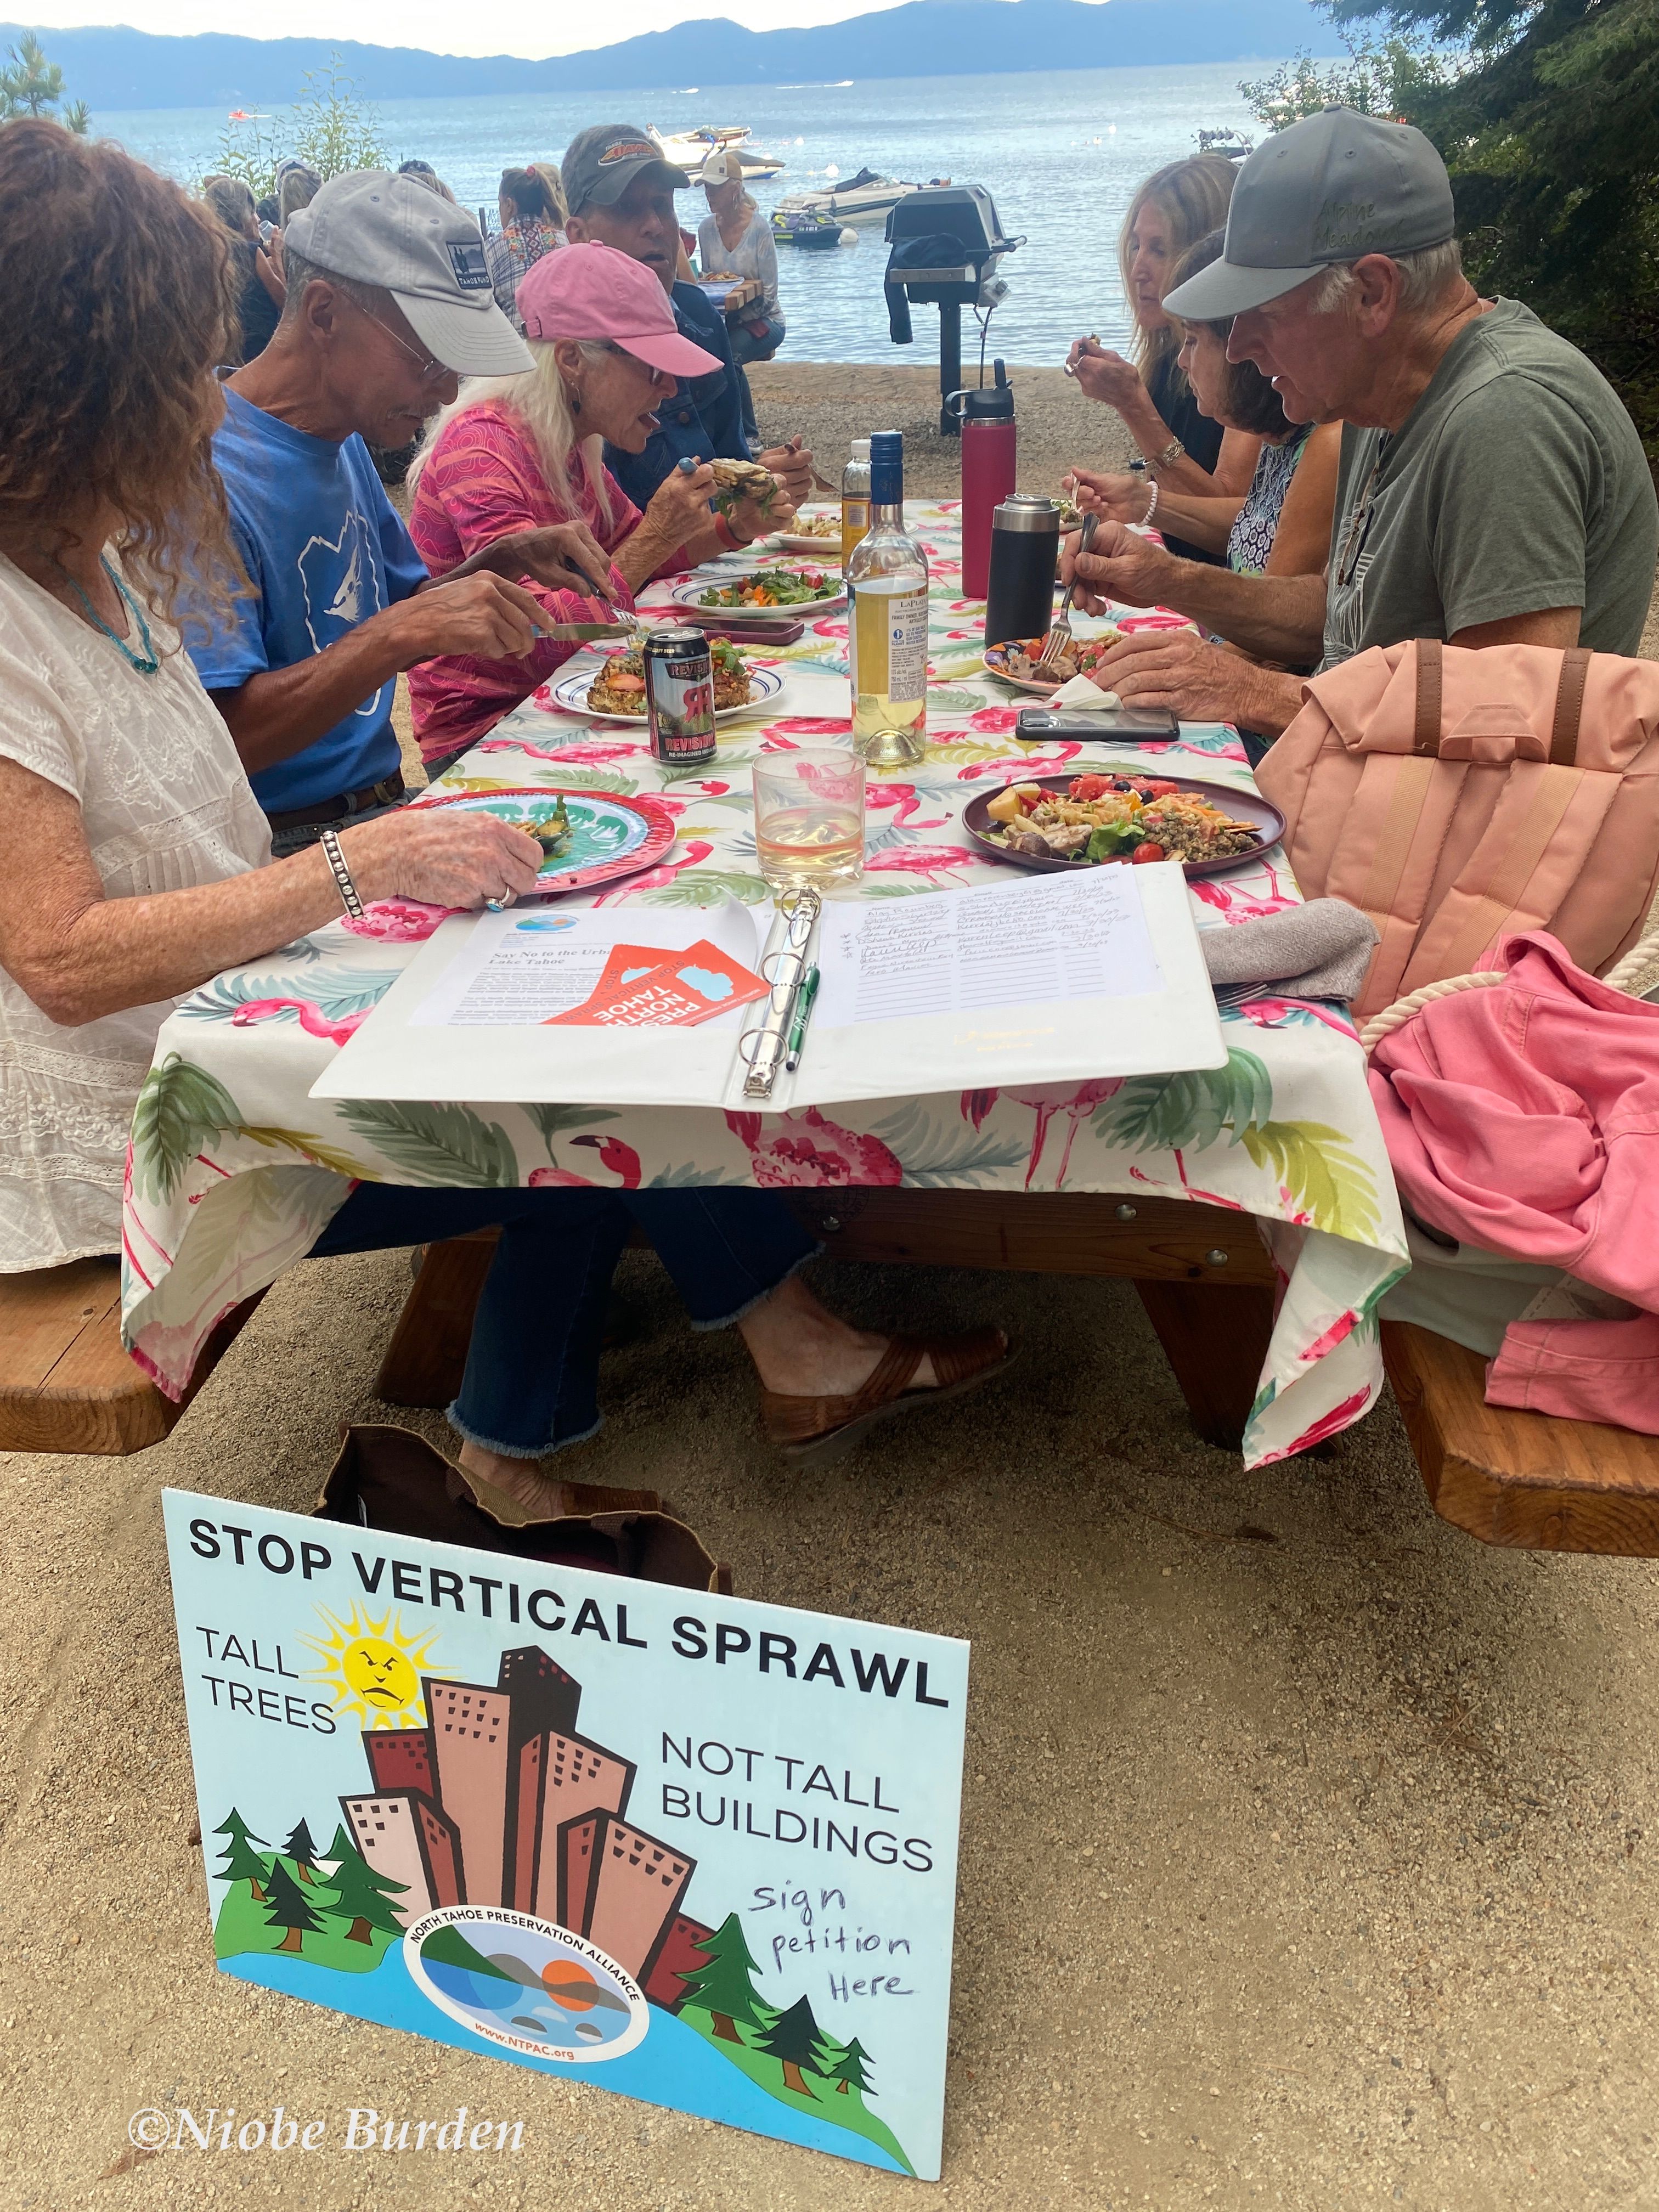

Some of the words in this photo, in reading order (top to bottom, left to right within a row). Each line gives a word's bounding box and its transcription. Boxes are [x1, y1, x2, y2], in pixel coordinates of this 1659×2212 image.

[1318, 199, 1376, 223] Alpine
[1315, 218, 1405, 251] Meadows
[603, 969, 620, 990] STOP
[657, 959, 685, 978] STOP
[592, 985, 672, 1020] TAHOE
[605, 975, 657, 1003] VERTICAL
[556, 1000, 605, 1024] SPRAWL
[604, 992, 687, 1027] NORTH
[190, 1519, 331, 1580] STOP
[351, 1551, 647, 1649] VERTICAL
[672, 1616, 949, 1708] SPRAWL
[196, 1626, 299, 1679] TALL
[201, 1674, 337, 1735] TREES
[662, 1731, 764, 1782] NOT
[775, 1756, 899, 1813] TALL
[663, 1784, 933, 1872] BUILDINGS
[748, 1881, 845, 1926] sign
[410, 1912, 442, 1944] NORTH
[441, 1909, 484, 1926] TAHOE
[487, 1911, 584, 1951] PRESERVATION
[585, 1949, 640, 2001] ALLIANCE
[772, 1926, 911, 1974] petition
[828, 1971, 914, 2002] Here
[475, 2022, 575, 2061] www.NTPAC.org
